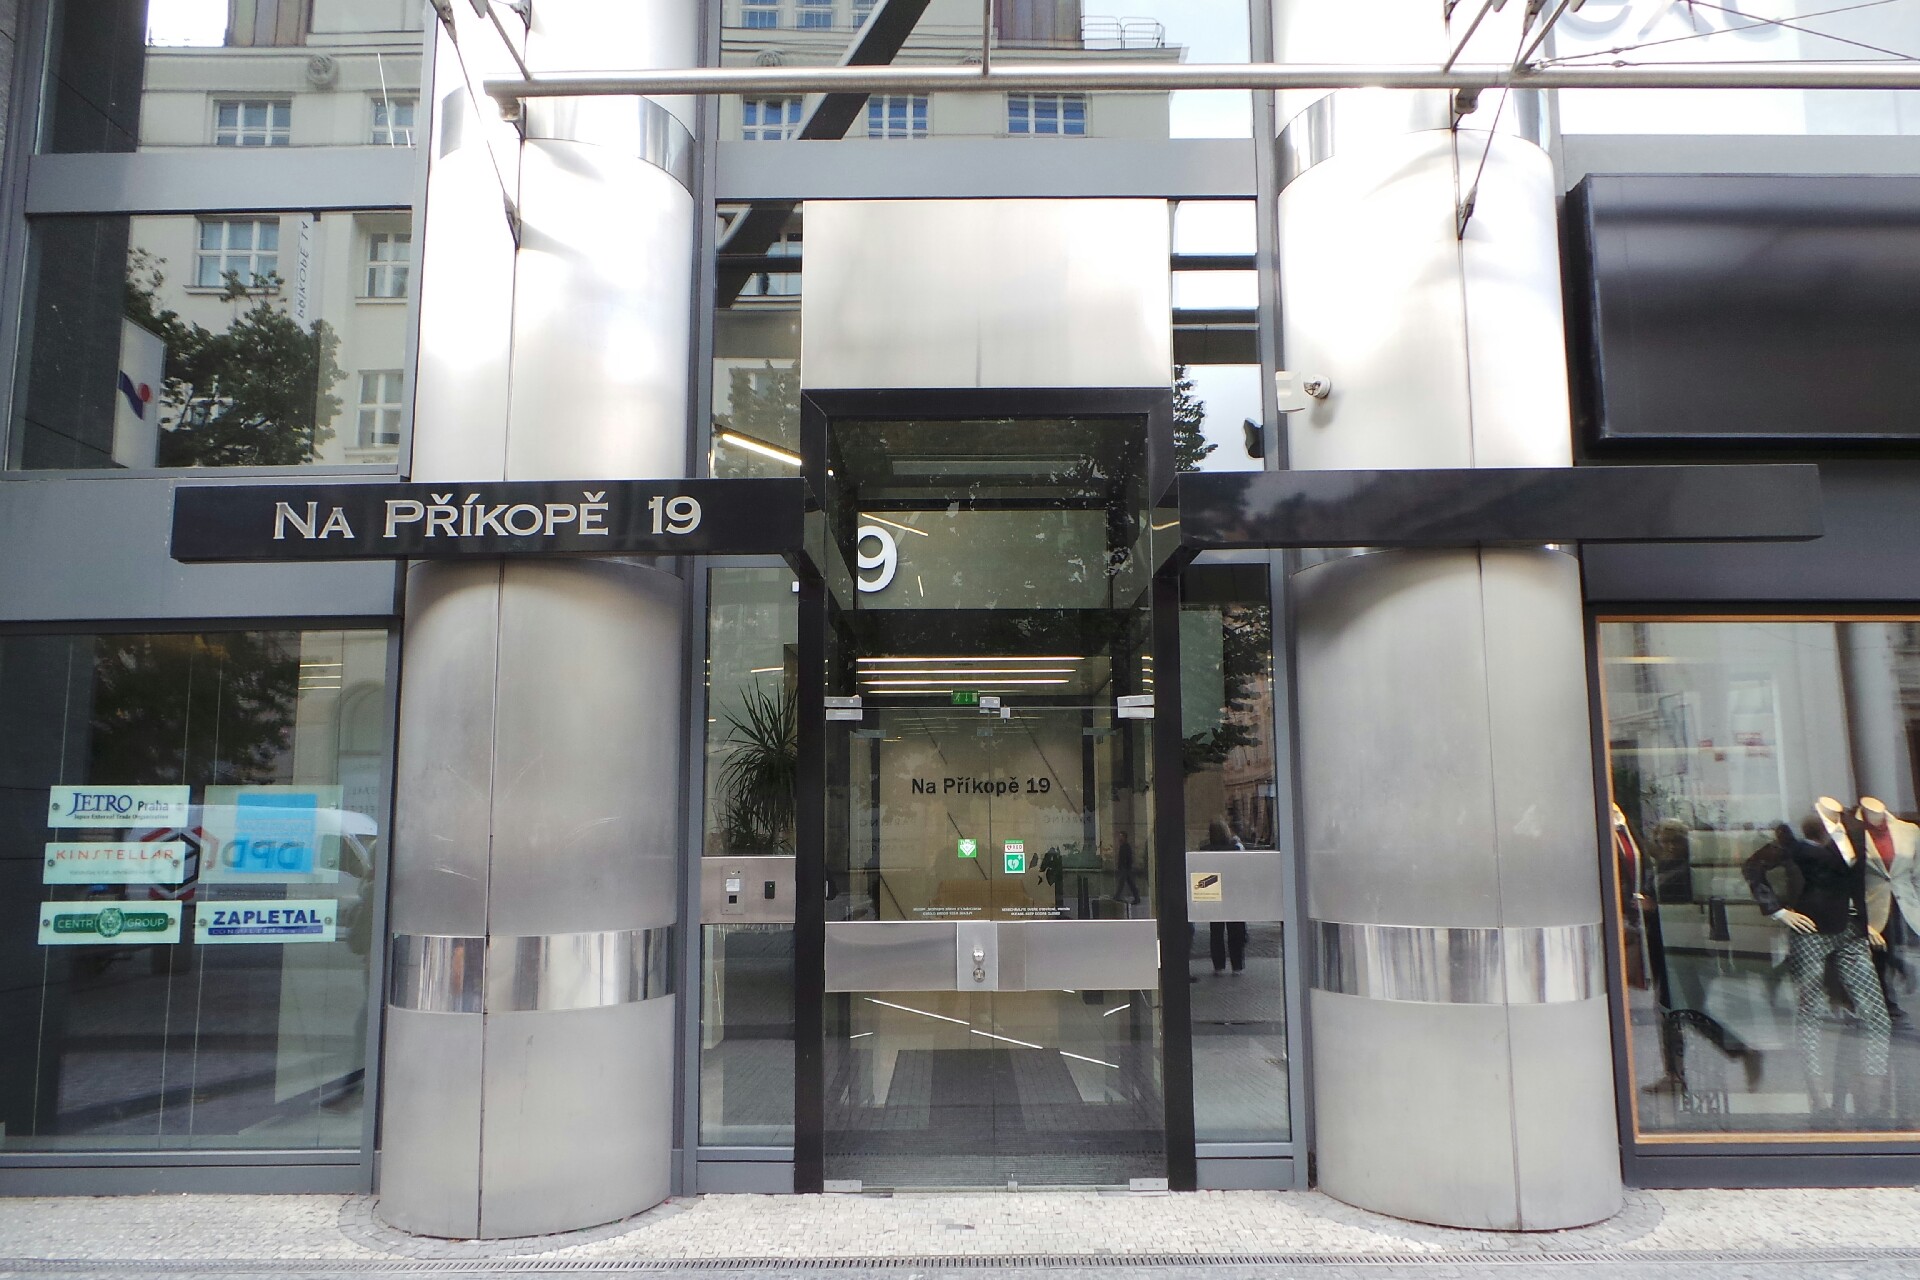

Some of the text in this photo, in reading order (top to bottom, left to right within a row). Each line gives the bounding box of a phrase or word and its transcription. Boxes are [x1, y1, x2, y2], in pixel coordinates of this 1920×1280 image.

[273, 491, 702, 540] NA PŘÍKOPĚ 19
[912, 777, 1051, 797] Na Příkopě 19
[66, 792, 169, 816] JETRO Praha
[56, 849, 174, 860] KINSTELLAR
[127, 918, 165, 928] GROUP
[213, 909, 321, 925] ZAPLETAL
